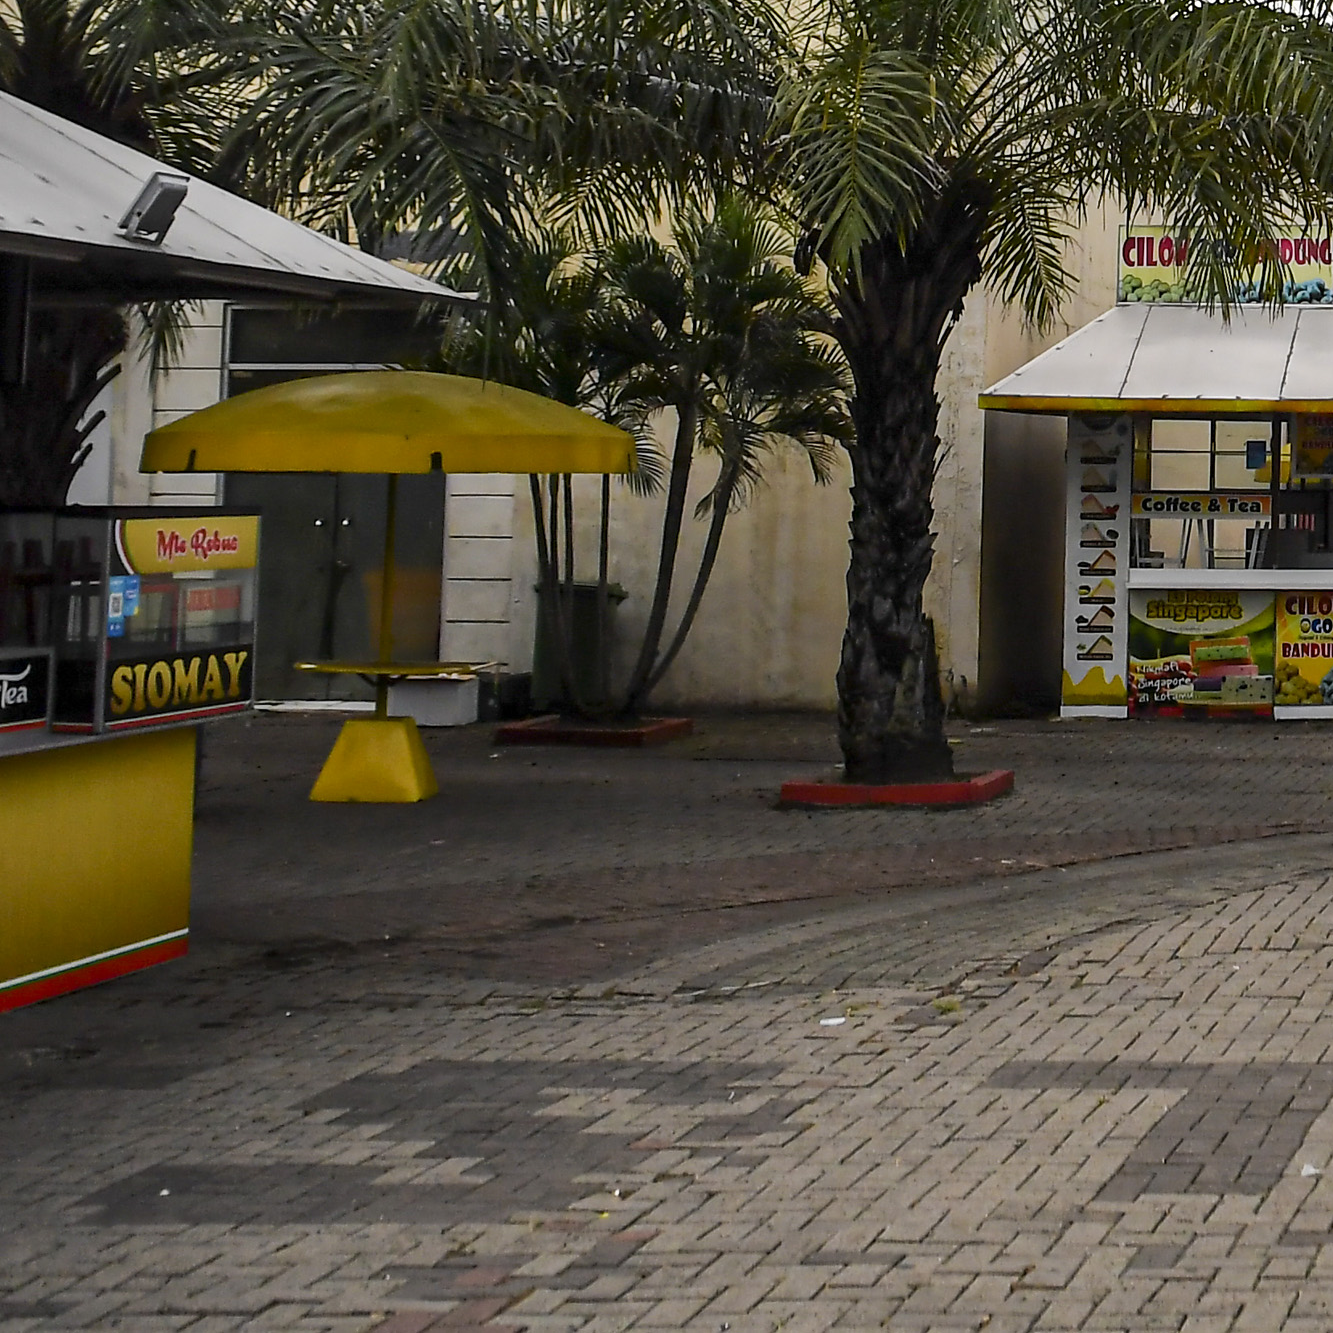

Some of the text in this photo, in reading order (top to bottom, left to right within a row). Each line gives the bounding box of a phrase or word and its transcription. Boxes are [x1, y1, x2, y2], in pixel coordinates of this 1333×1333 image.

[1141, 498, 1262, 513] Coffee & Tea
[1146, 601, 1244, 622] Singapore
[1299, 617, 1333, 634] OGO
[111, 651, 247, 715] SIOMAY
[1138, 676, 1192, 692] Singapore
